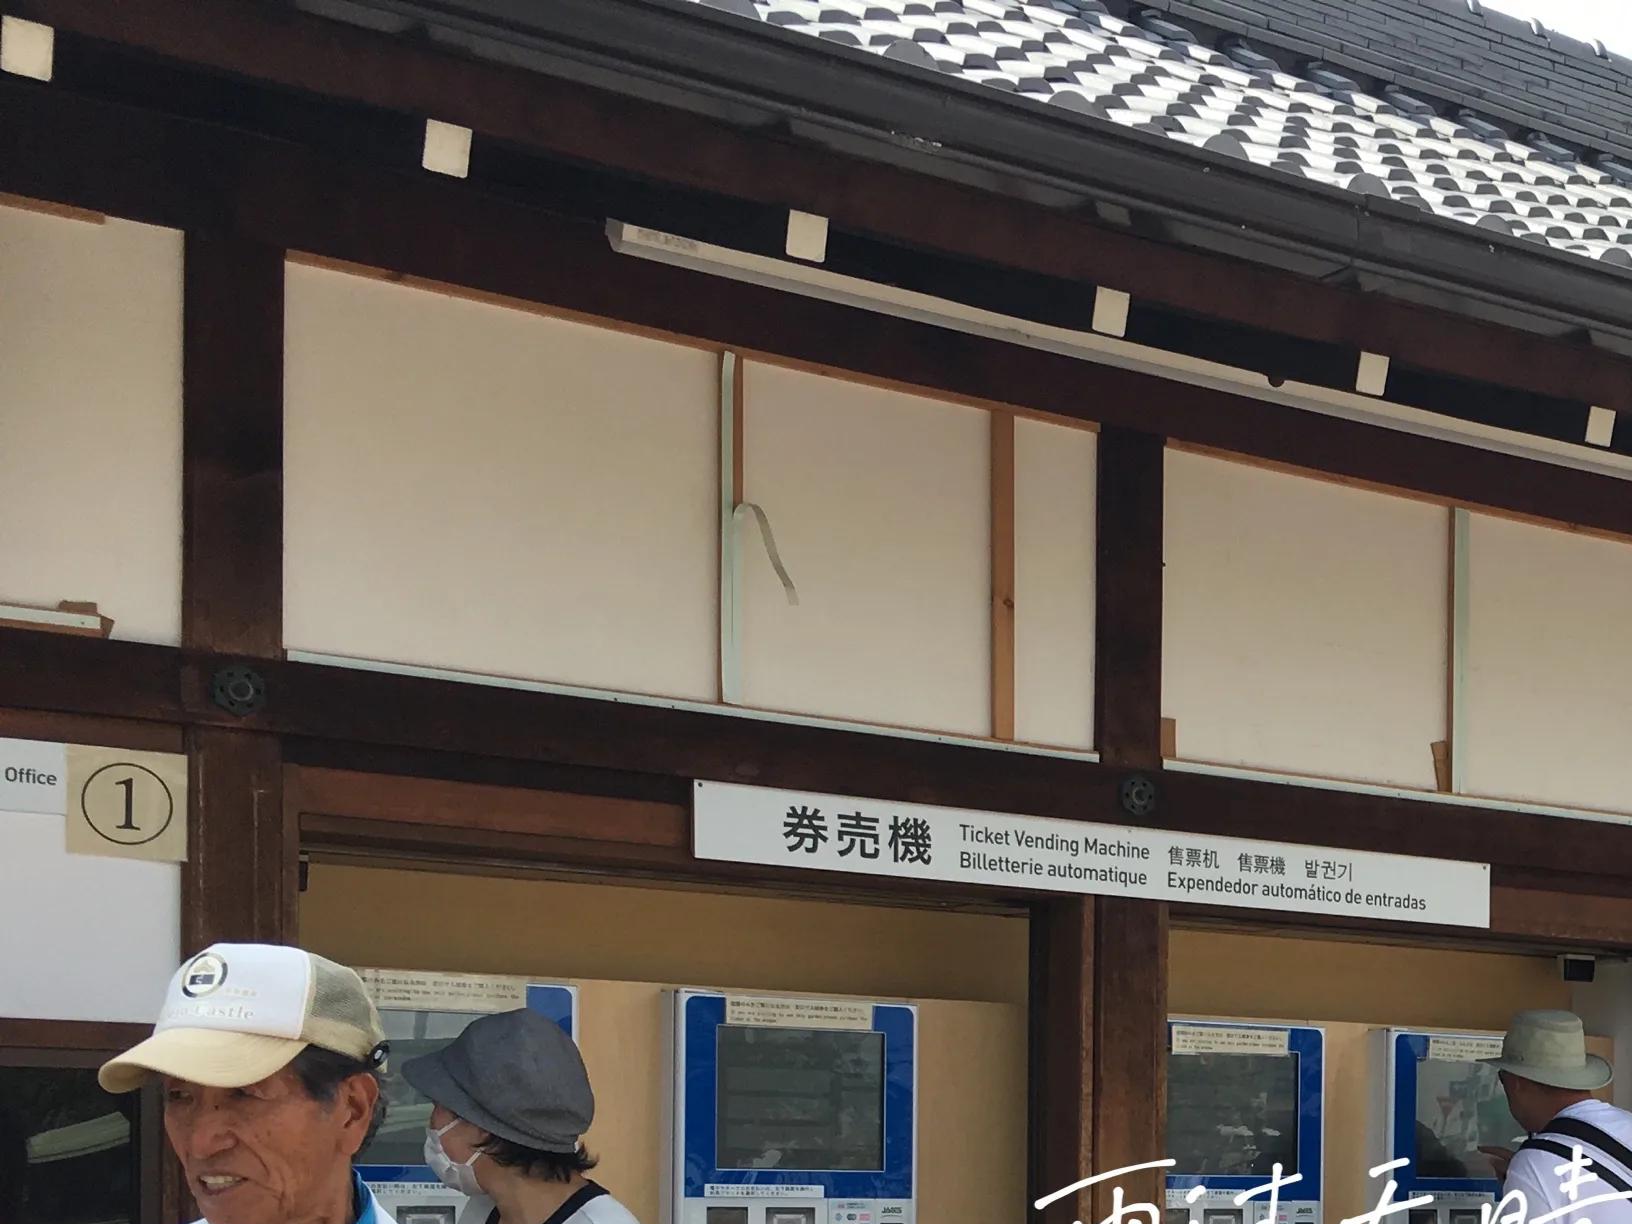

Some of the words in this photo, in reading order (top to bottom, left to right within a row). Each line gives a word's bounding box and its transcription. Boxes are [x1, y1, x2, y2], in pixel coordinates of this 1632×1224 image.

[4, 766, 58, 786] Office
[782, 805, 932, 866] 券売機
[959, 823, 1011, 846] Ticket
[1014, 830, 1080, 857] Vending
[1083, 838, 1151, 860] Machine
[959, 851, 1043, 876] Billetterie
[1047, 862, 1148, 888] automatique
[1167, 845, 1221, 870] 售票机
[1236, 852, 1286, 876] 售票機
[1304, 859, 1354, 882] 발권기
[1167, 871, 1259, 897] Expendedor
[1261, 883, 1342, 903] automático
[1344, 888, 1362, 906] de
[1365, 893, 1427, 911] entradas
